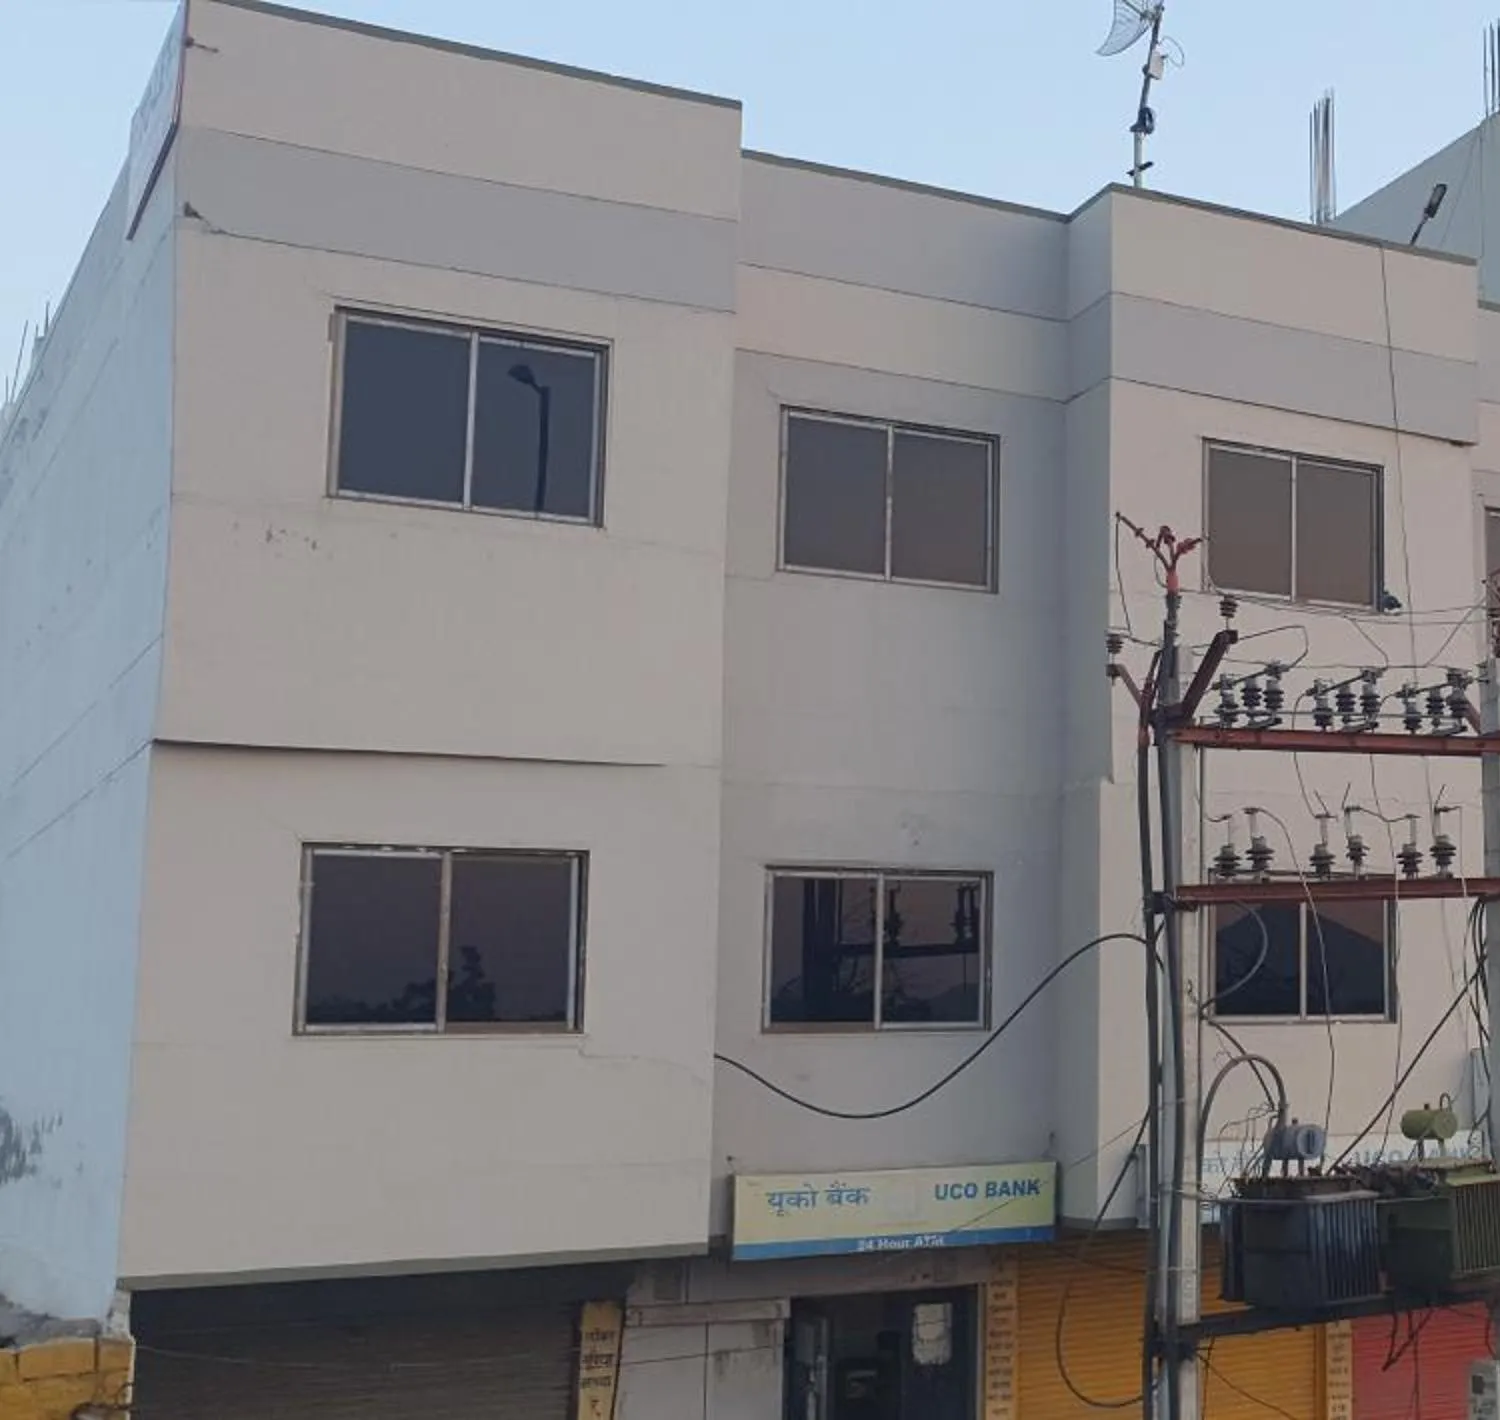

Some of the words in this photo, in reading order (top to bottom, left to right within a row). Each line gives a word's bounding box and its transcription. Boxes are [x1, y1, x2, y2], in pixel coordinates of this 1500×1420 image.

[765, 1183, 819, 1217] यूको
[934, 1182, 979, 1201] UCO
[984, 1178, 1041, 1199] BANK
